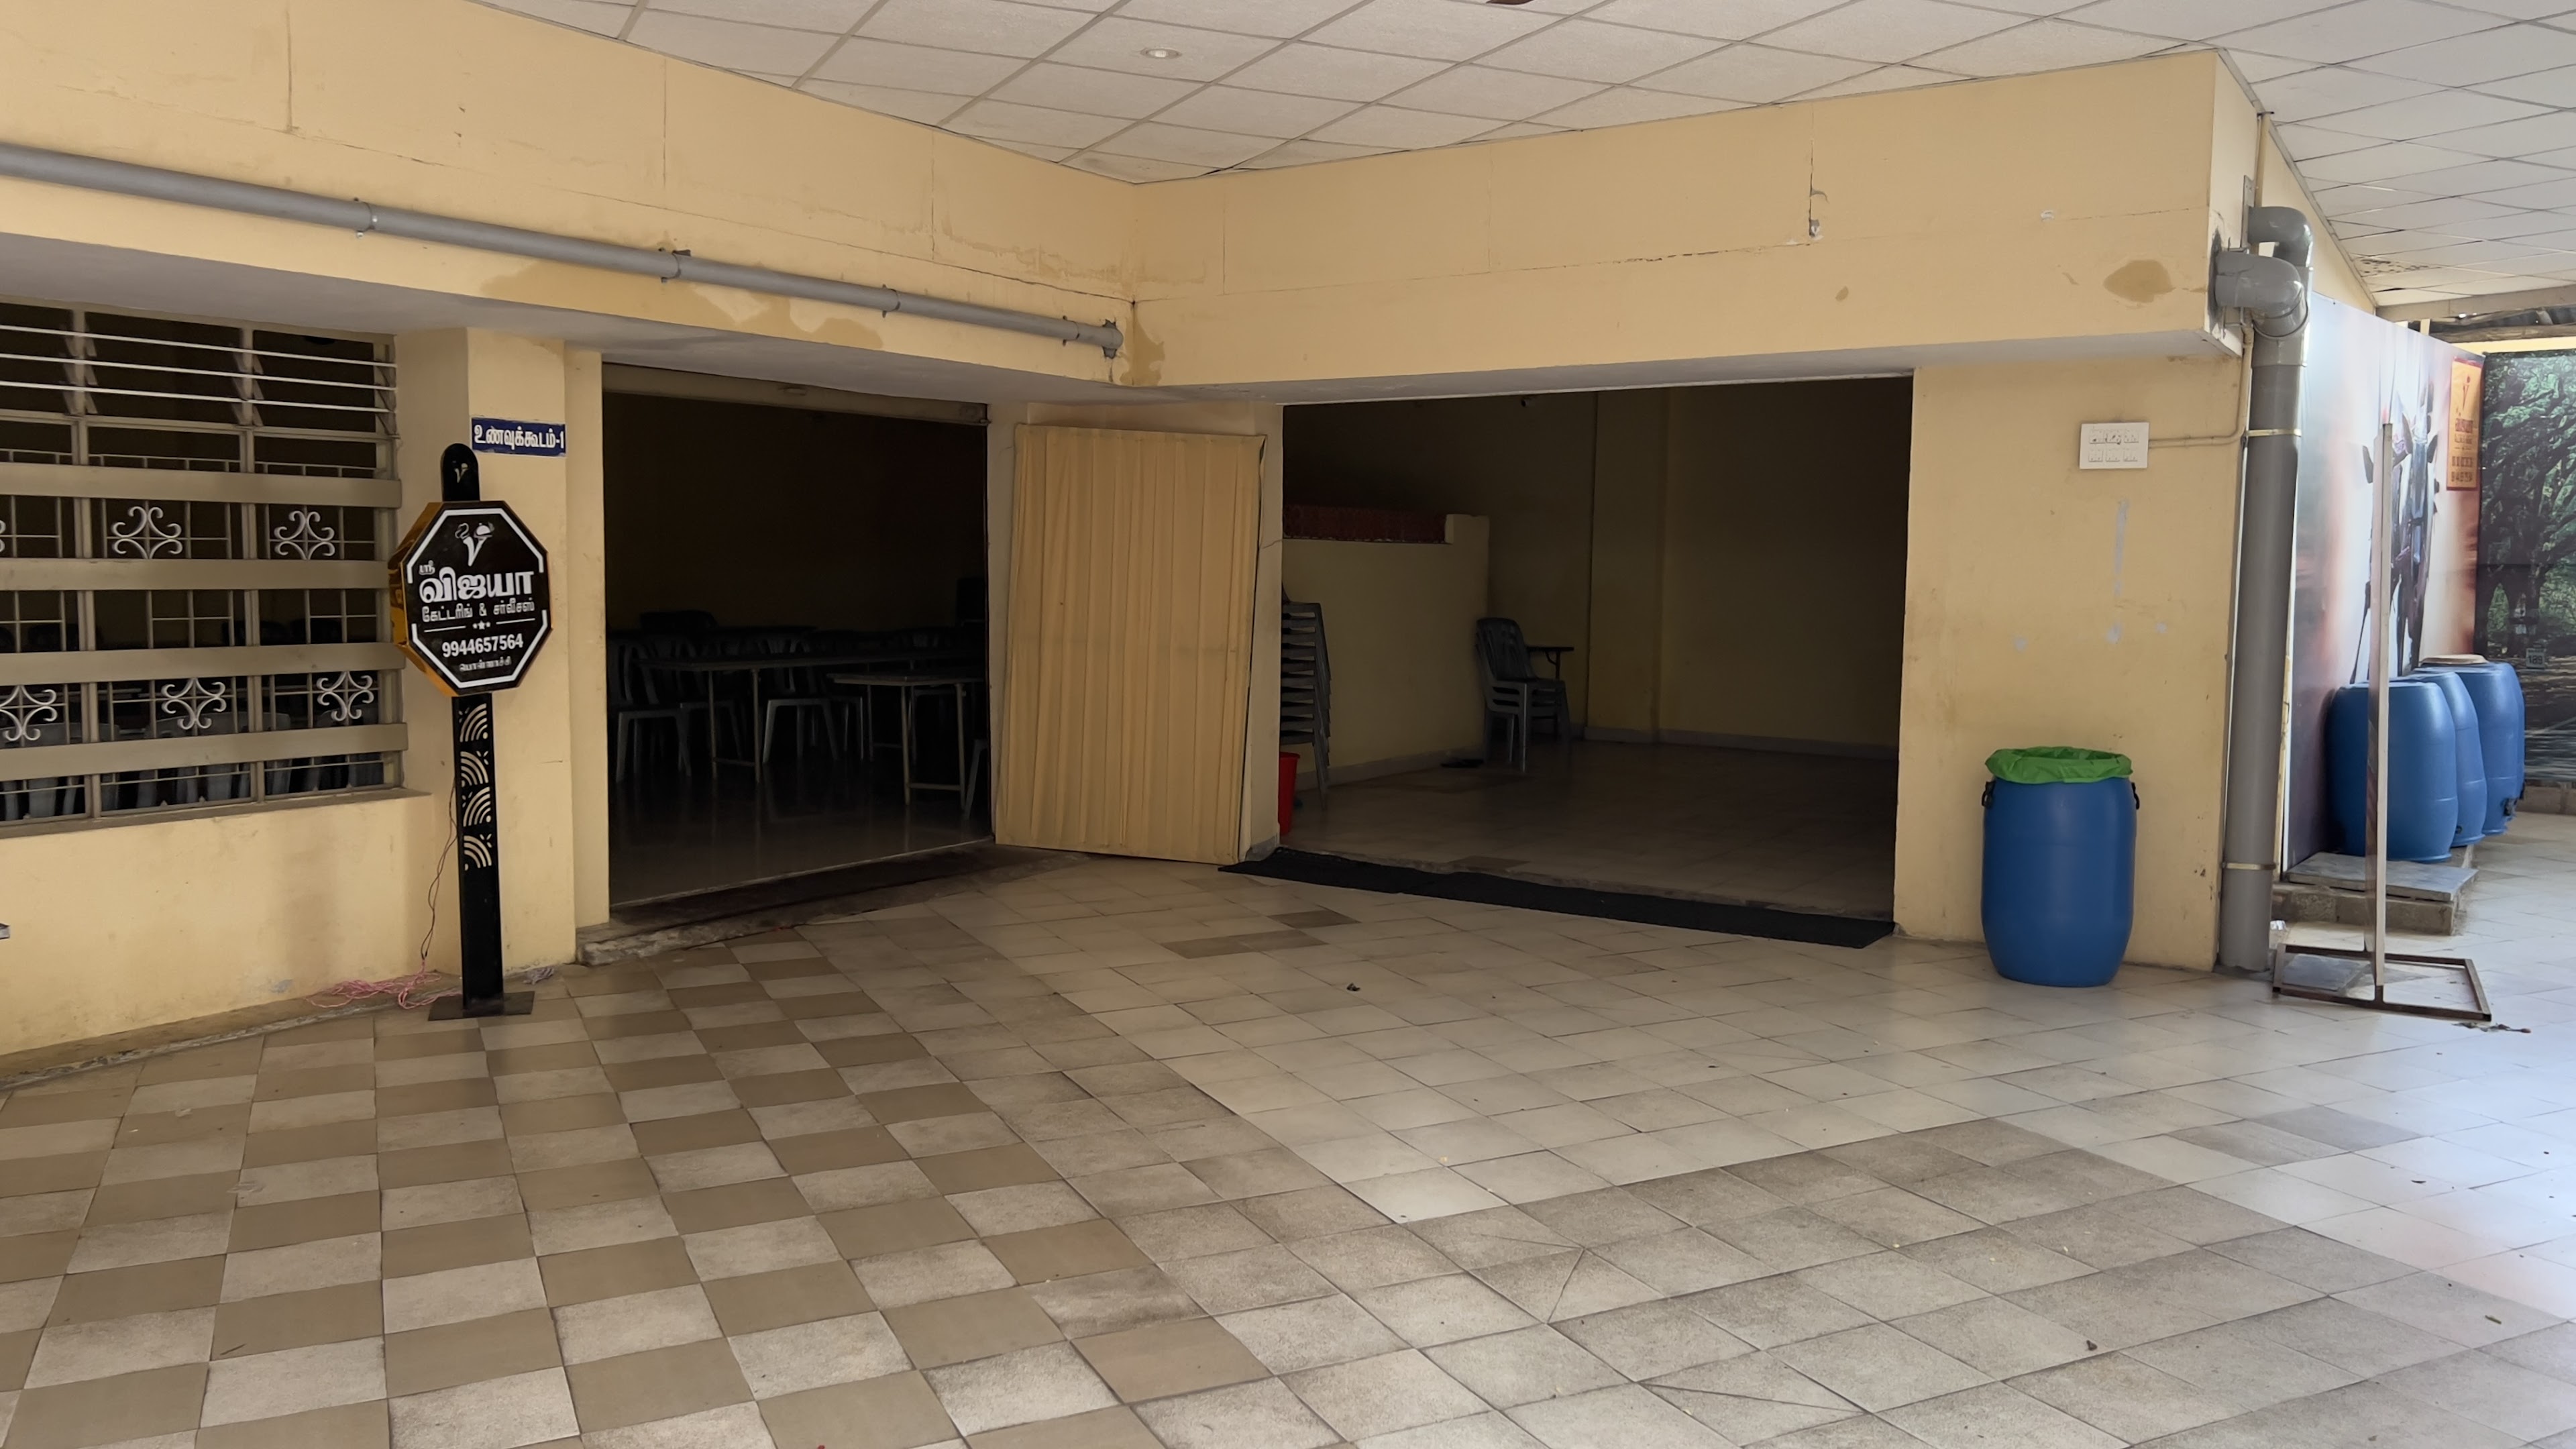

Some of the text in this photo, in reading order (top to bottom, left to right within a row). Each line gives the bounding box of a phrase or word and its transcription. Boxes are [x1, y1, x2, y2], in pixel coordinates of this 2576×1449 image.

[474, 424, 564, 450] உணவுக்கூடம்-1
[419, 566, 535, 604] விஜயா
[421, 597, 535, 623] கேட்டரிங் & சர்வீசஸ்
[441, 633, 524, 658] 9944657564
